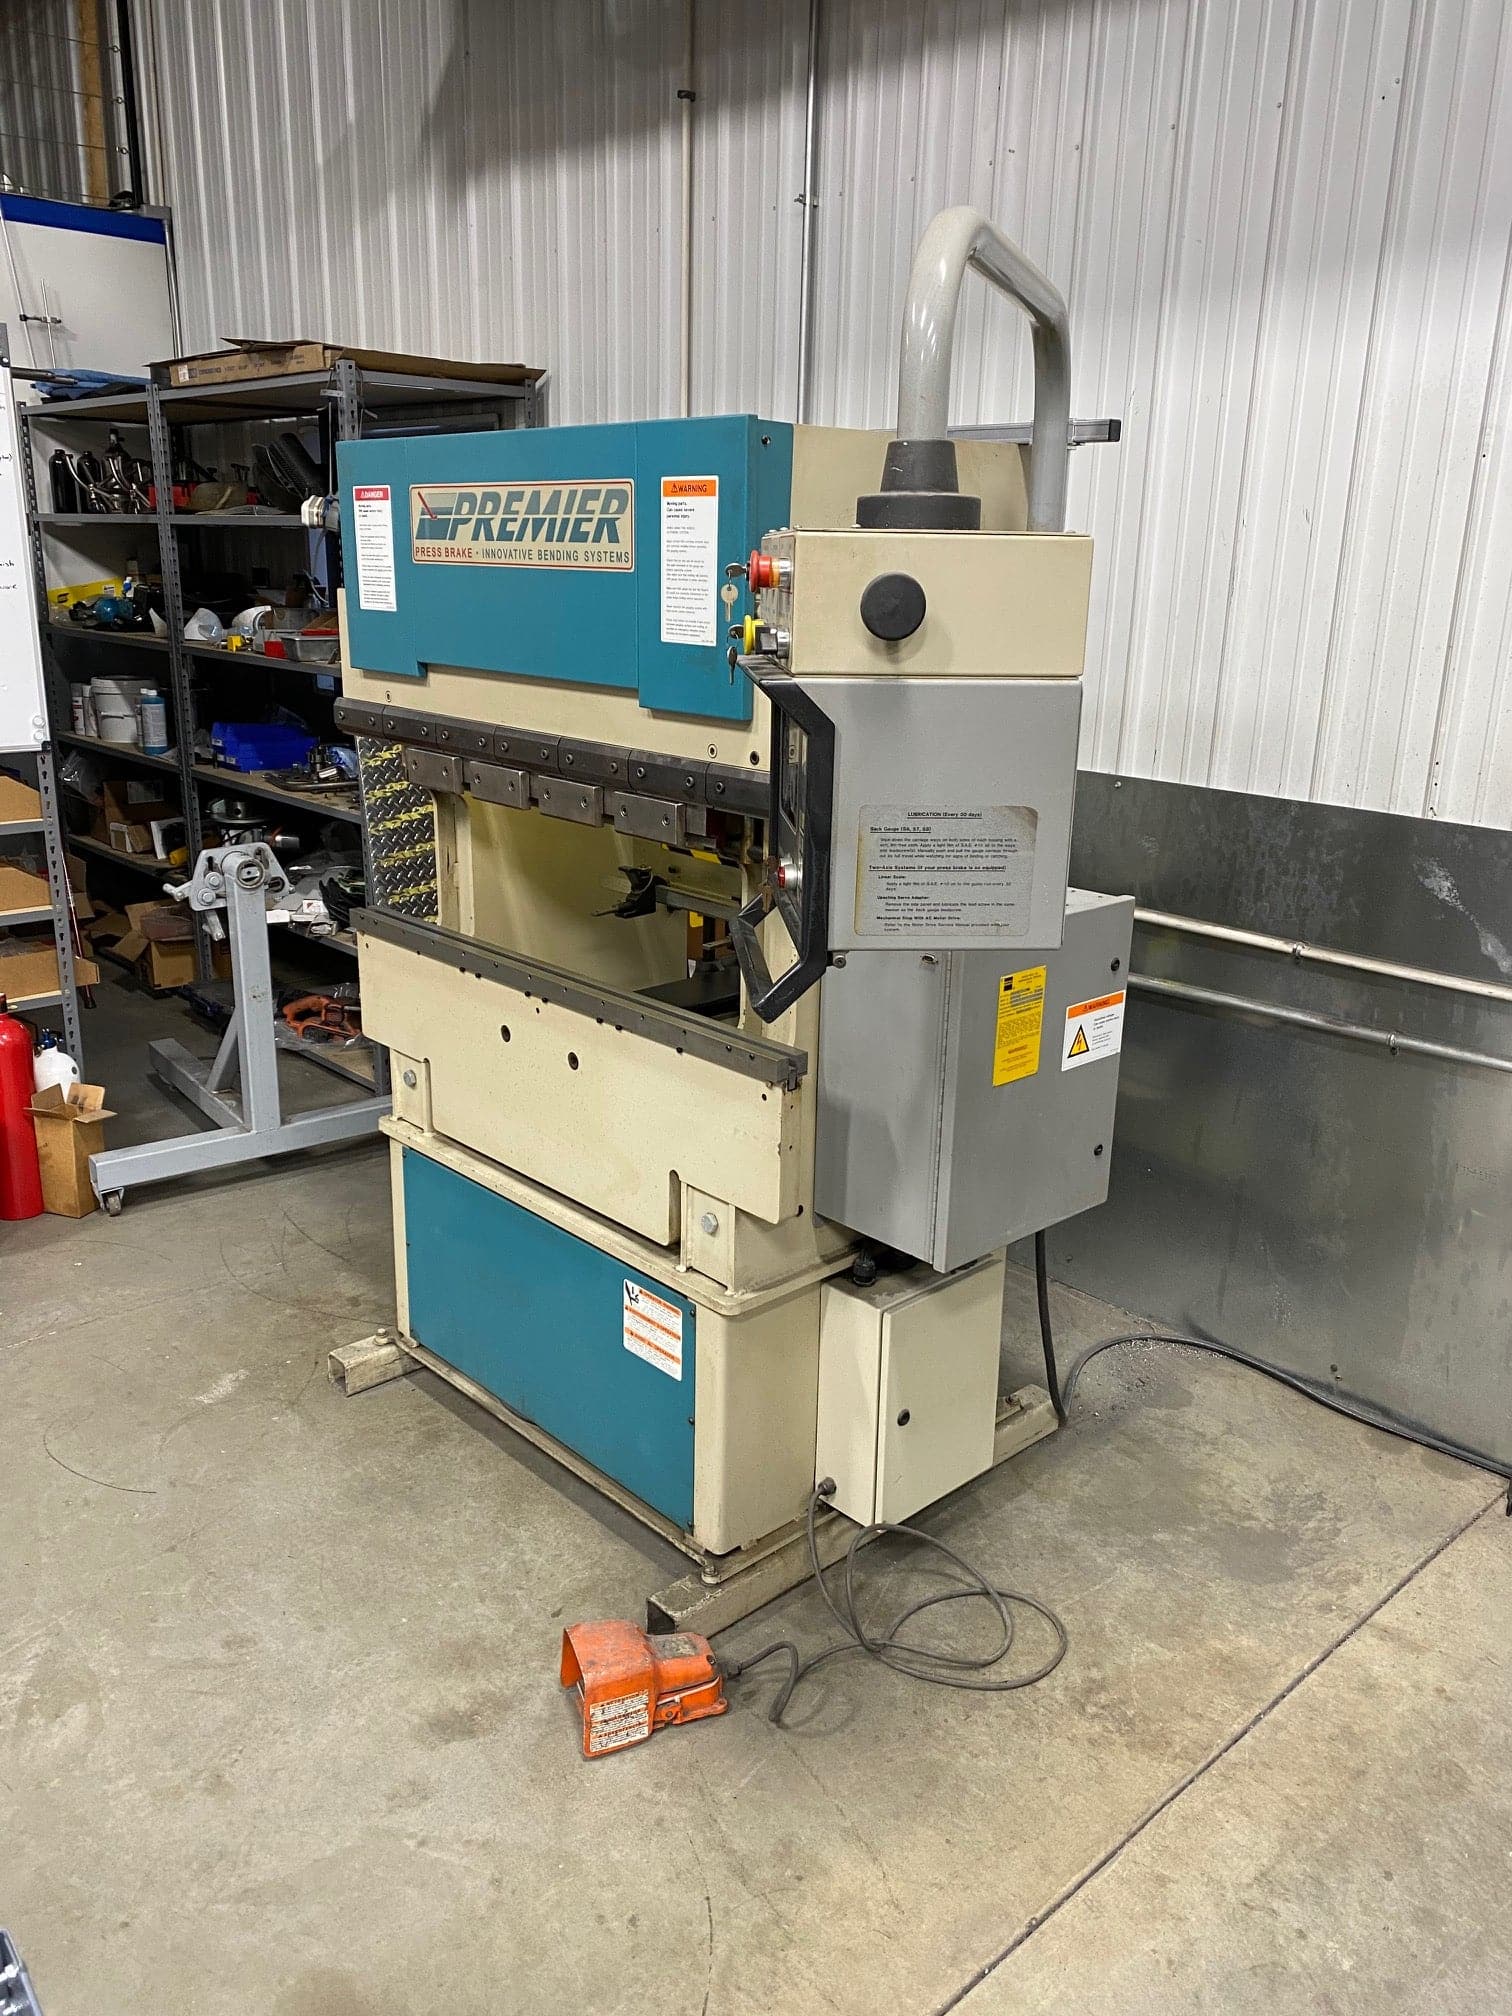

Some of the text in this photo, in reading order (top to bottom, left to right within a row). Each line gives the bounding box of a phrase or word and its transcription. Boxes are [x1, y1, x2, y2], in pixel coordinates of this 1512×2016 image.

[678, 484, 707, 492] WARNING
[448, 488, 629, 543] PREMIER
[415, 546, 630, 563] PRESS BRAKE INNOVATIVE BENDING SYSTEMS
